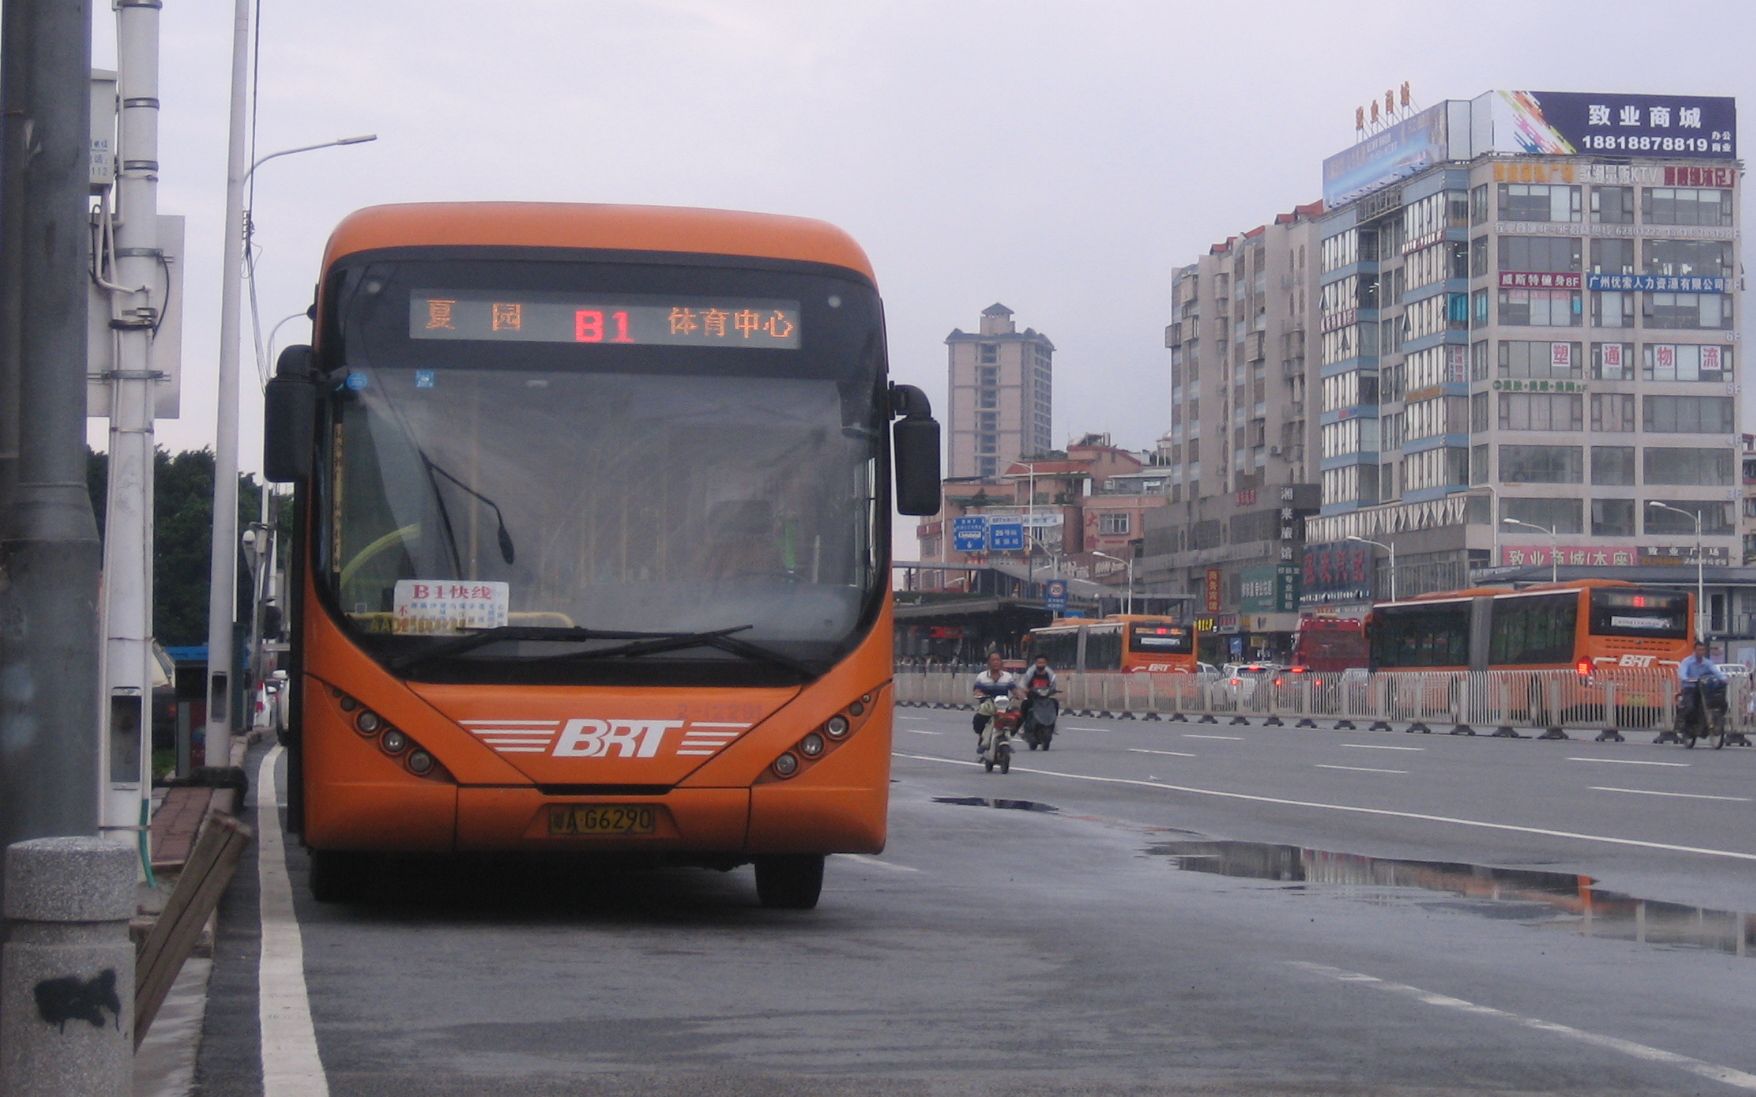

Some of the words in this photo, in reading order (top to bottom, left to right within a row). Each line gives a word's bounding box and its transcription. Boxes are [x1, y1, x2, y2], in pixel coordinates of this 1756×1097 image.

[1588, 104, 1702, 129] 致业商城
[1582, 135, 1708, 152] 18818878819
[1711, 131, 1732, 141] 办公
[575, 309, 635, 344] B1
[667, 307, 794, 339] 体育中心
[411, 583, 493, 600] B1快线
[1618, 654, 1657, 668] BRT
[551, 718, 685, 758] BRT
